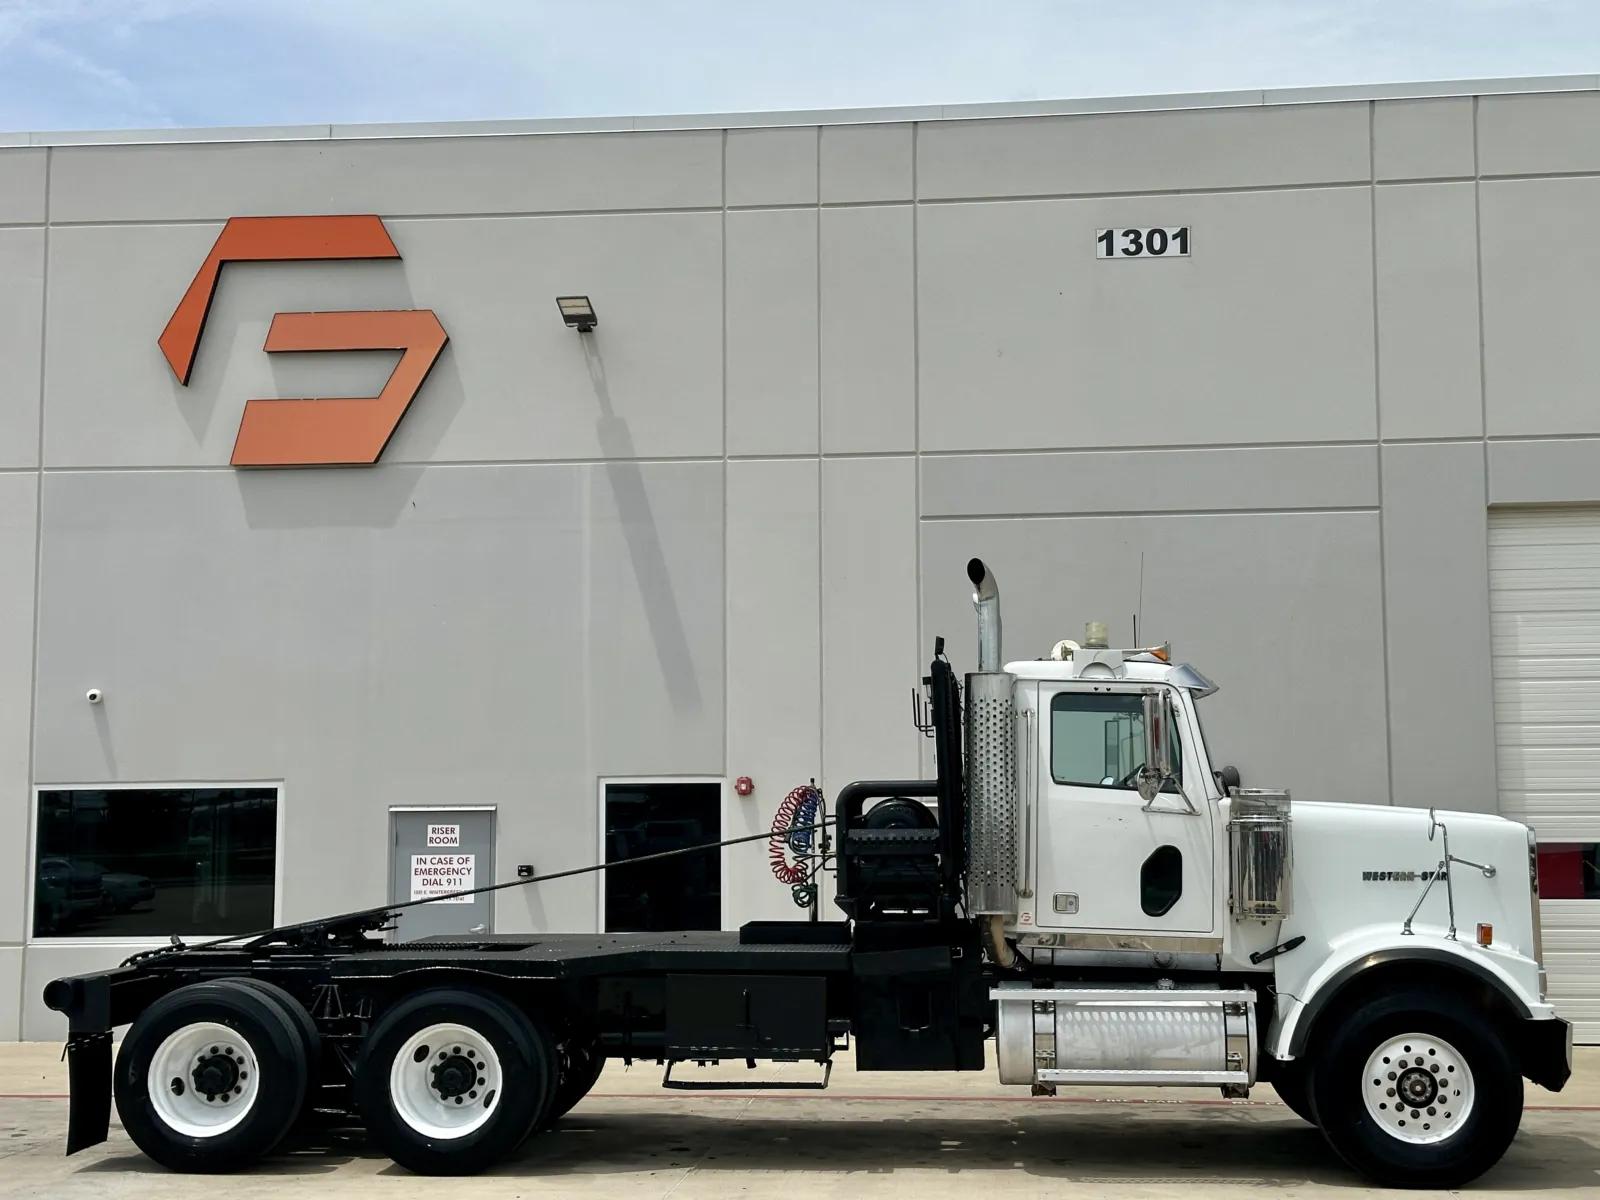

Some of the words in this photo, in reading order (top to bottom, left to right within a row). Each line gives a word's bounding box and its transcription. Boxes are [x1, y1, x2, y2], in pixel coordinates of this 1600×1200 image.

[1098, 227, 1188, 256] 1301
[431, 827, 456, 835] RISER
[429, 836, 458, 845] ROOM
[416, 857, 427, 866] IN
[430, 857, 454, 866] CASE
[457, 856, 471, 865] OF
[414, 867, 472, 876] EMERGENCY
[422, 878, 444, 887] DIAL
[446, 878, 463, 887] 911
